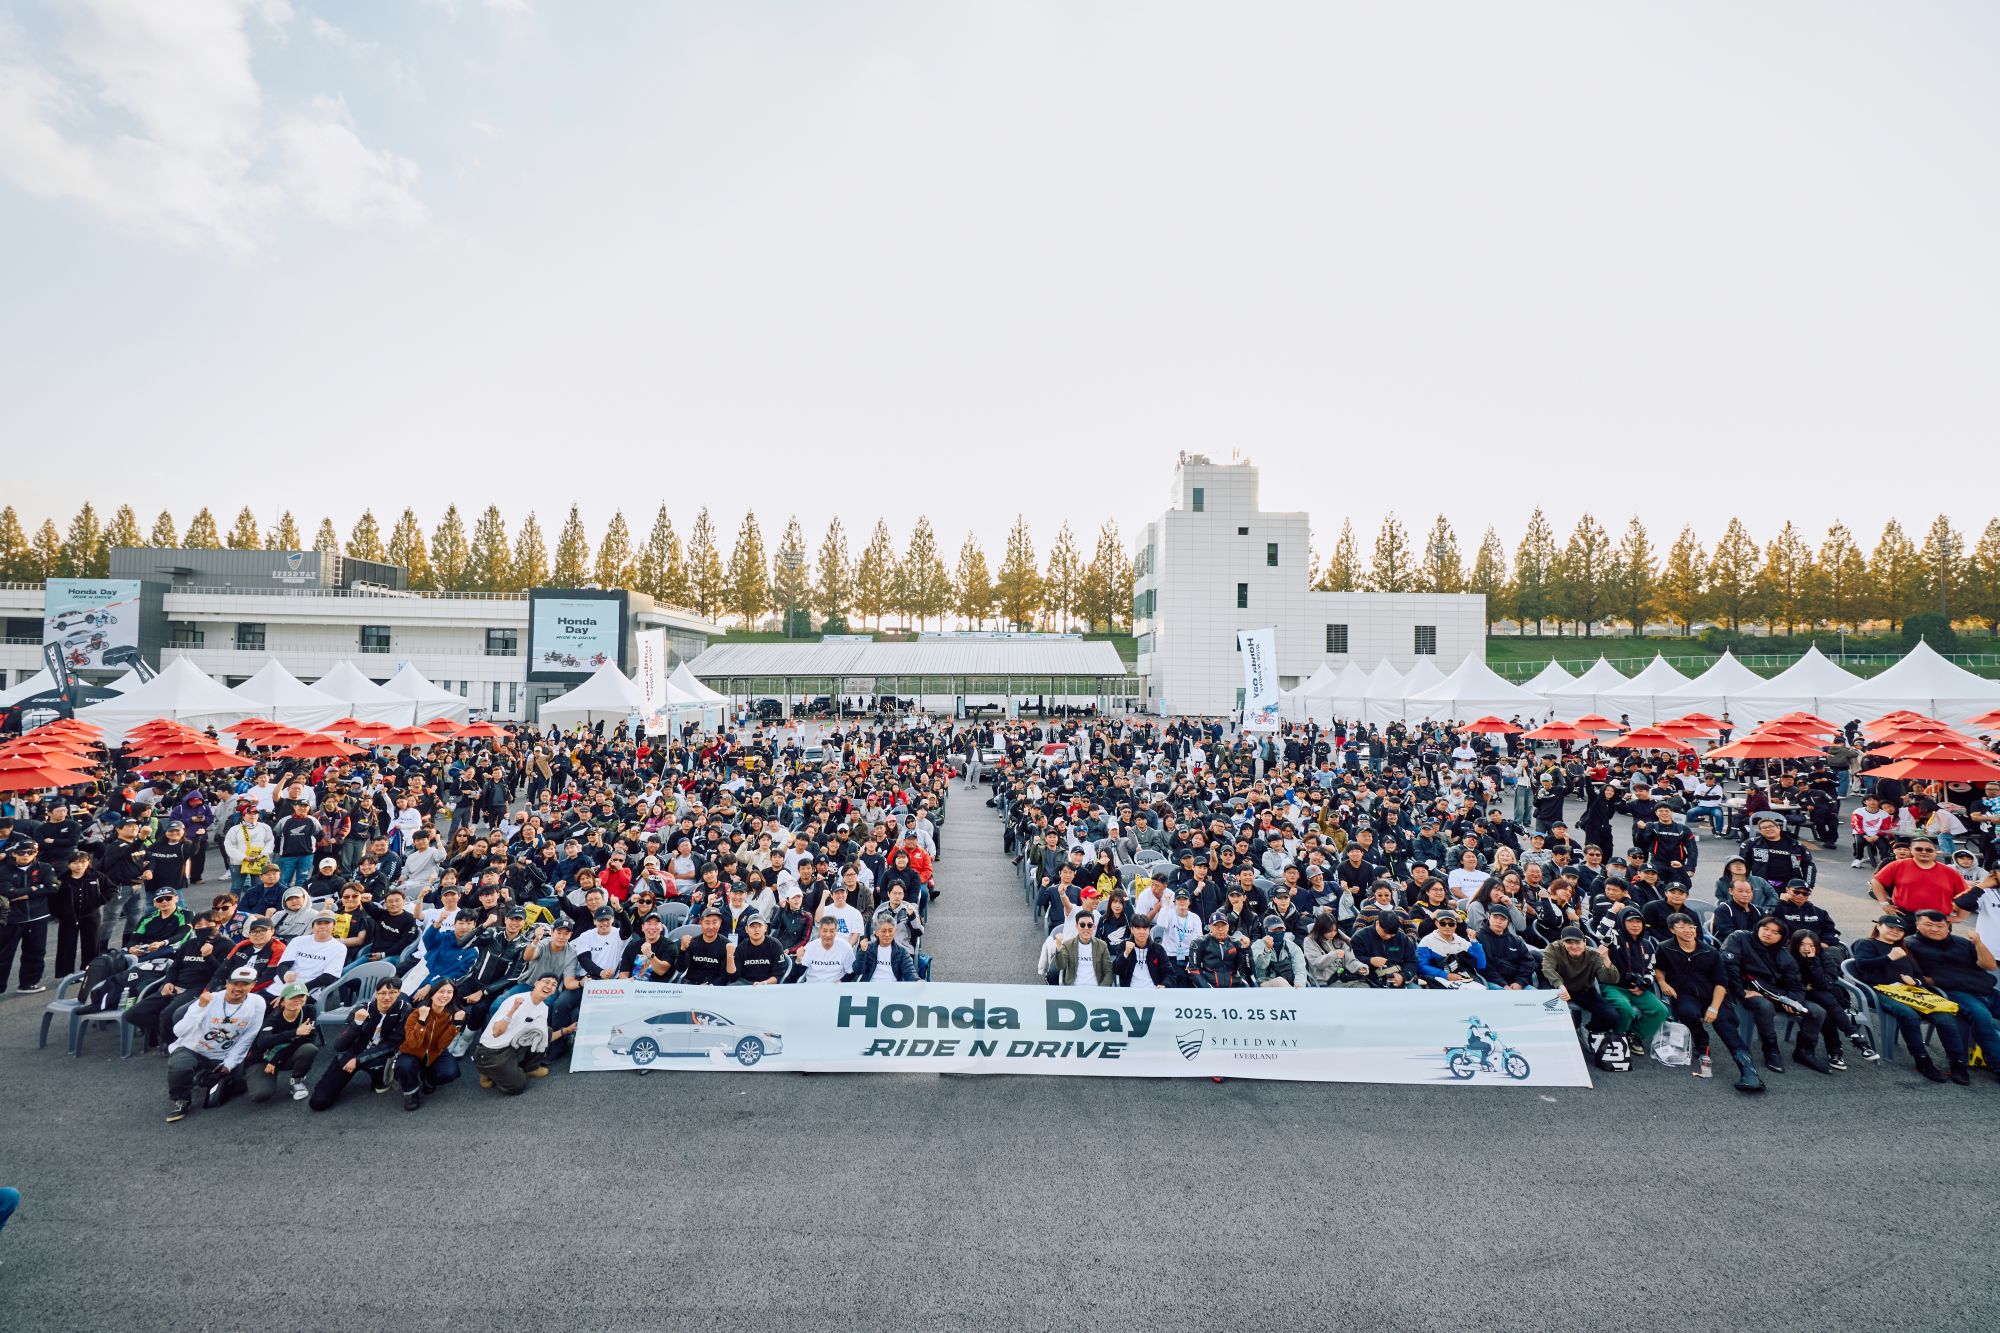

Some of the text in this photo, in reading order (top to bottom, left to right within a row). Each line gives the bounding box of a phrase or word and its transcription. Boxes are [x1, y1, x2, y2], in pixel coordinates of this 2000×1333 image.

[100, 588, 117, 596] Day
[557, 617, 597, 626] Honda
[565, 626, 589, 635] Day
[836, 995, 1156, 1038] Honda Day
[1174, 1007, 1297, 1021] 2025. 10. 25 SAT
[1211, 1036, 1299, 1047] SPEEDWAY
[862, 1038, 1129, 1060] RIDE N DRIVE
[1234, 1052, 1278, 1060] EVERLAND
